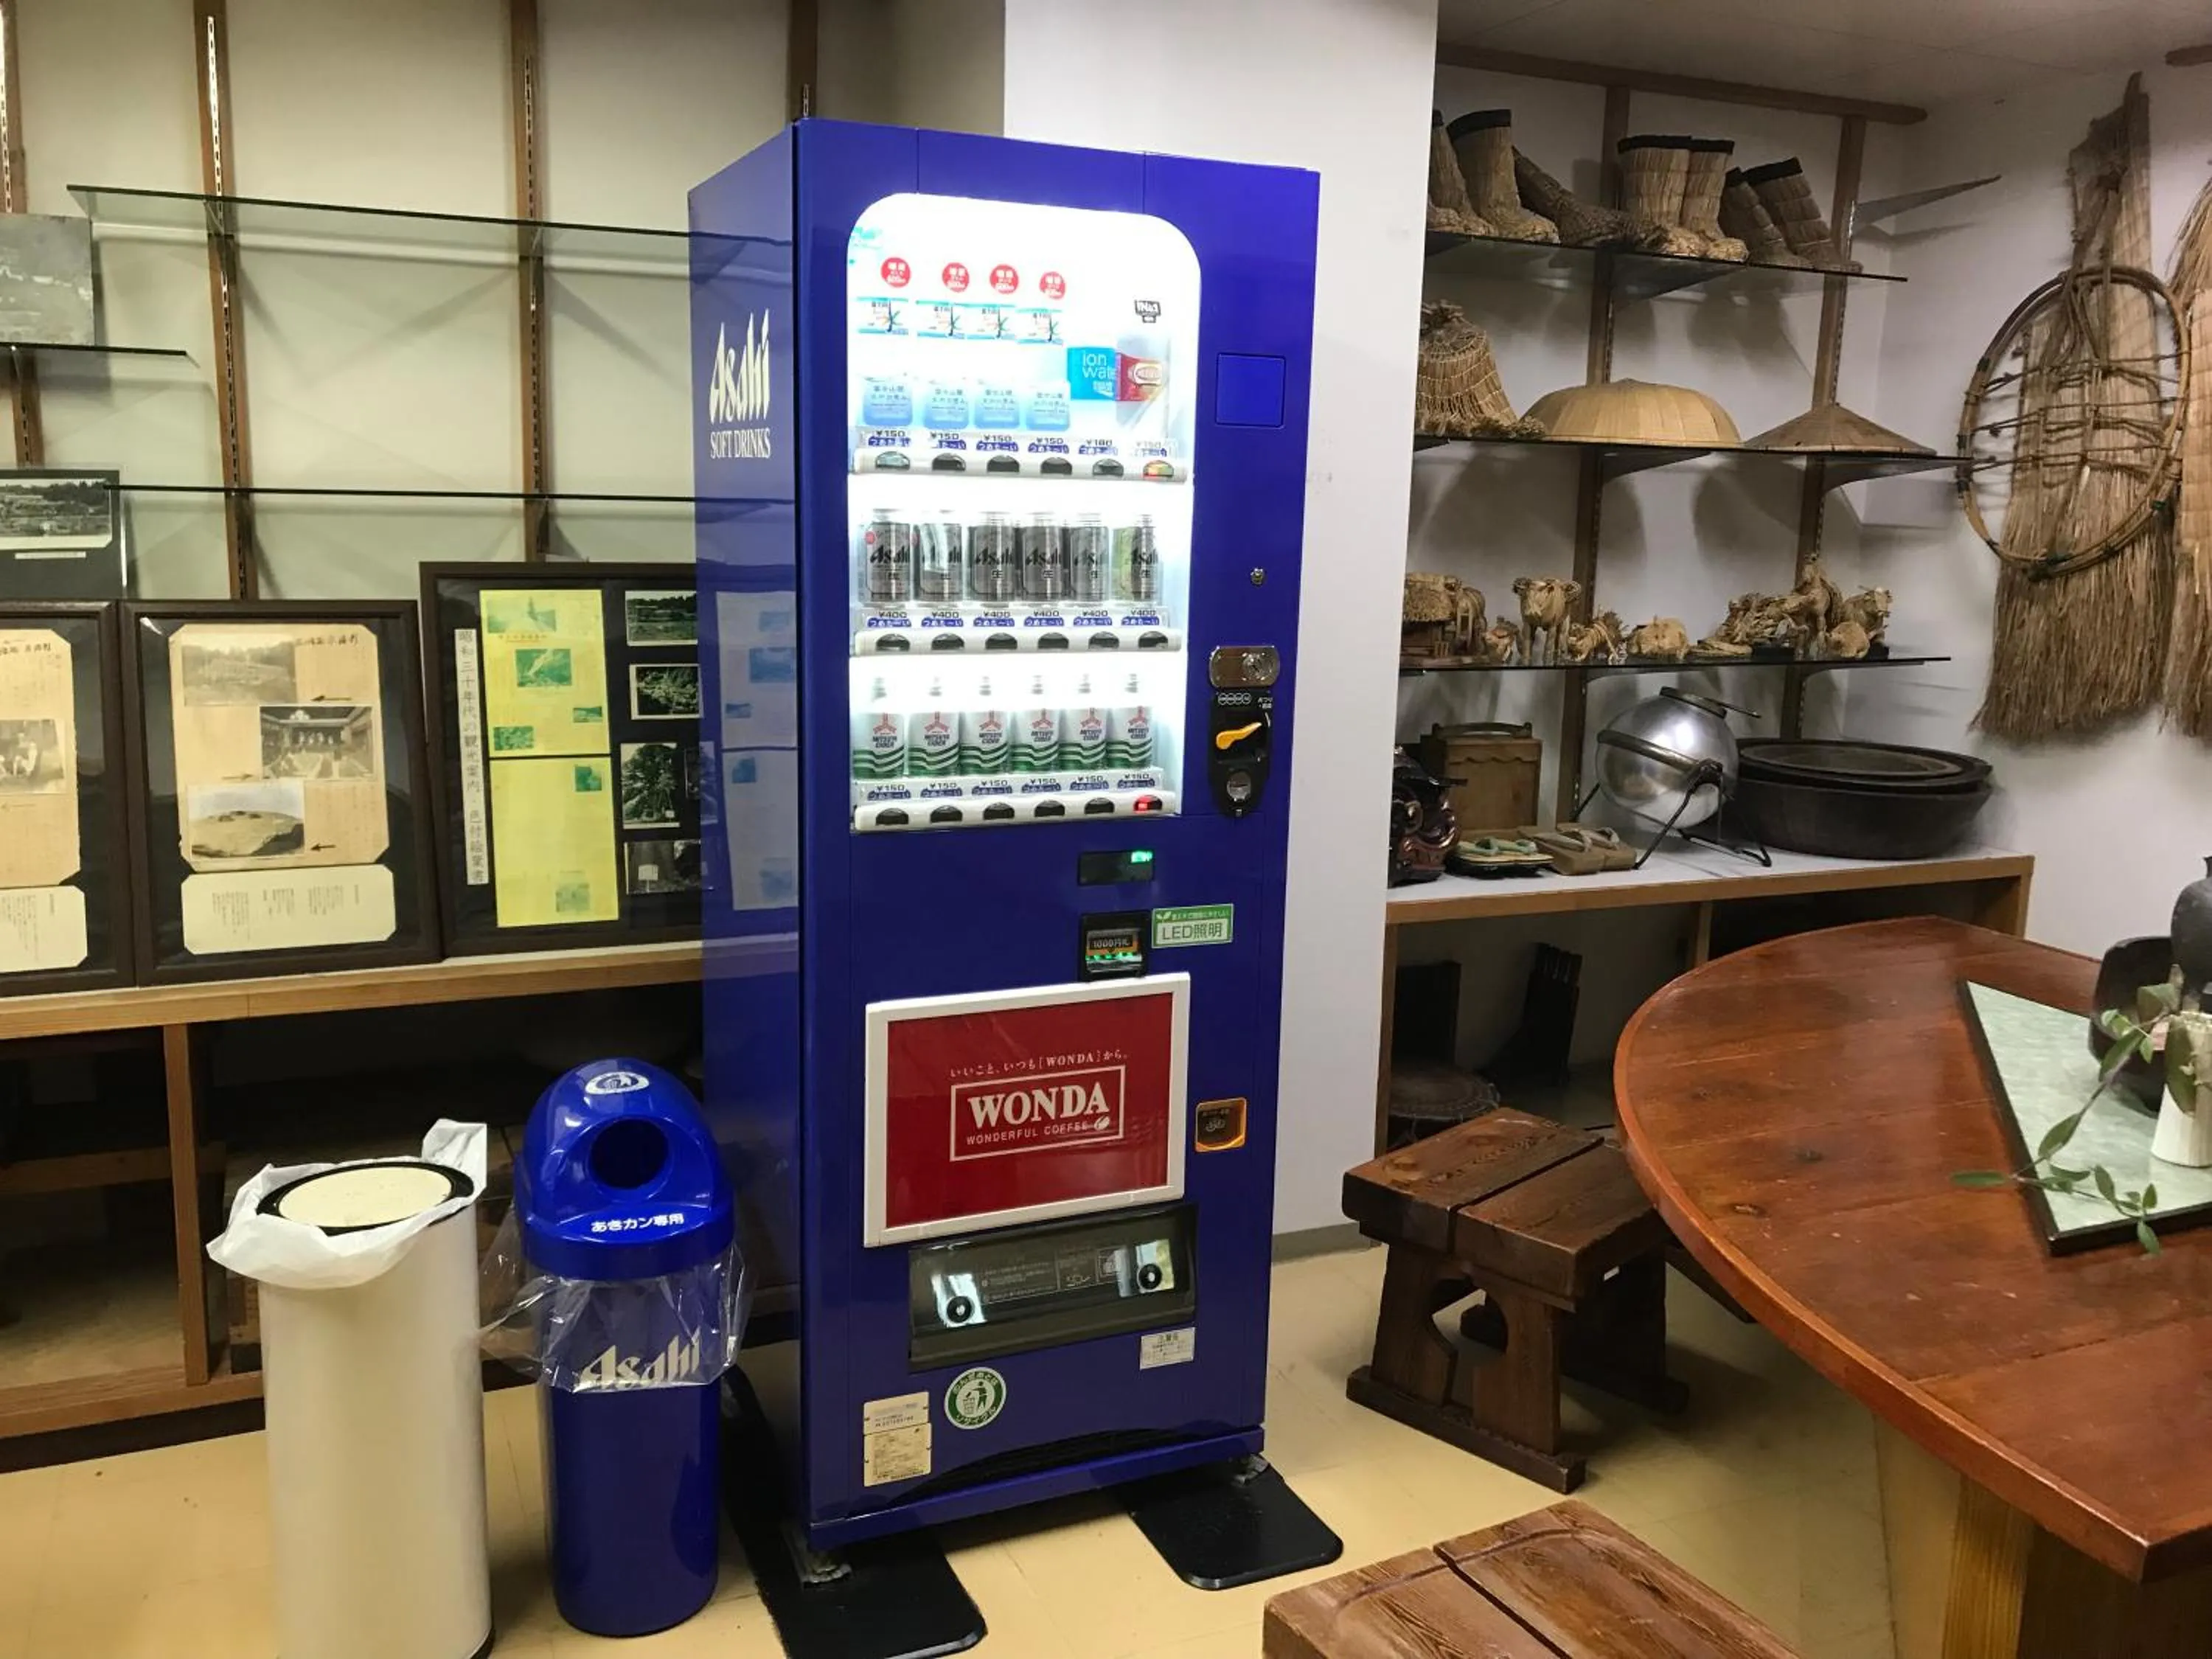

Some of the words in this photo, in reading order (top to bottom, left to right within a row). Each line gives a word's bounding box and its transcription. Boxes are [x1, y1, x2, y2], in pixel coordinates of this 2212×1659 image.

[709, 307, 771, 425] Asahi
[1083, 353, 1107, 366] ion
[710, 430, 732, 459] SOFT
[734, 428, 771, 459] DRINKS
[1162, 922, 1222, 940] LED照明
[967, 1081, 1110, 1130] WONDA
[966, 1128, 1039, 1146] WONDERFUL
[1043, 1121, 1089, 1135] COFFEE
[591, 1213, 685, 1234] あきカン専用
[576, 1327, 701, 1389] Asahi
